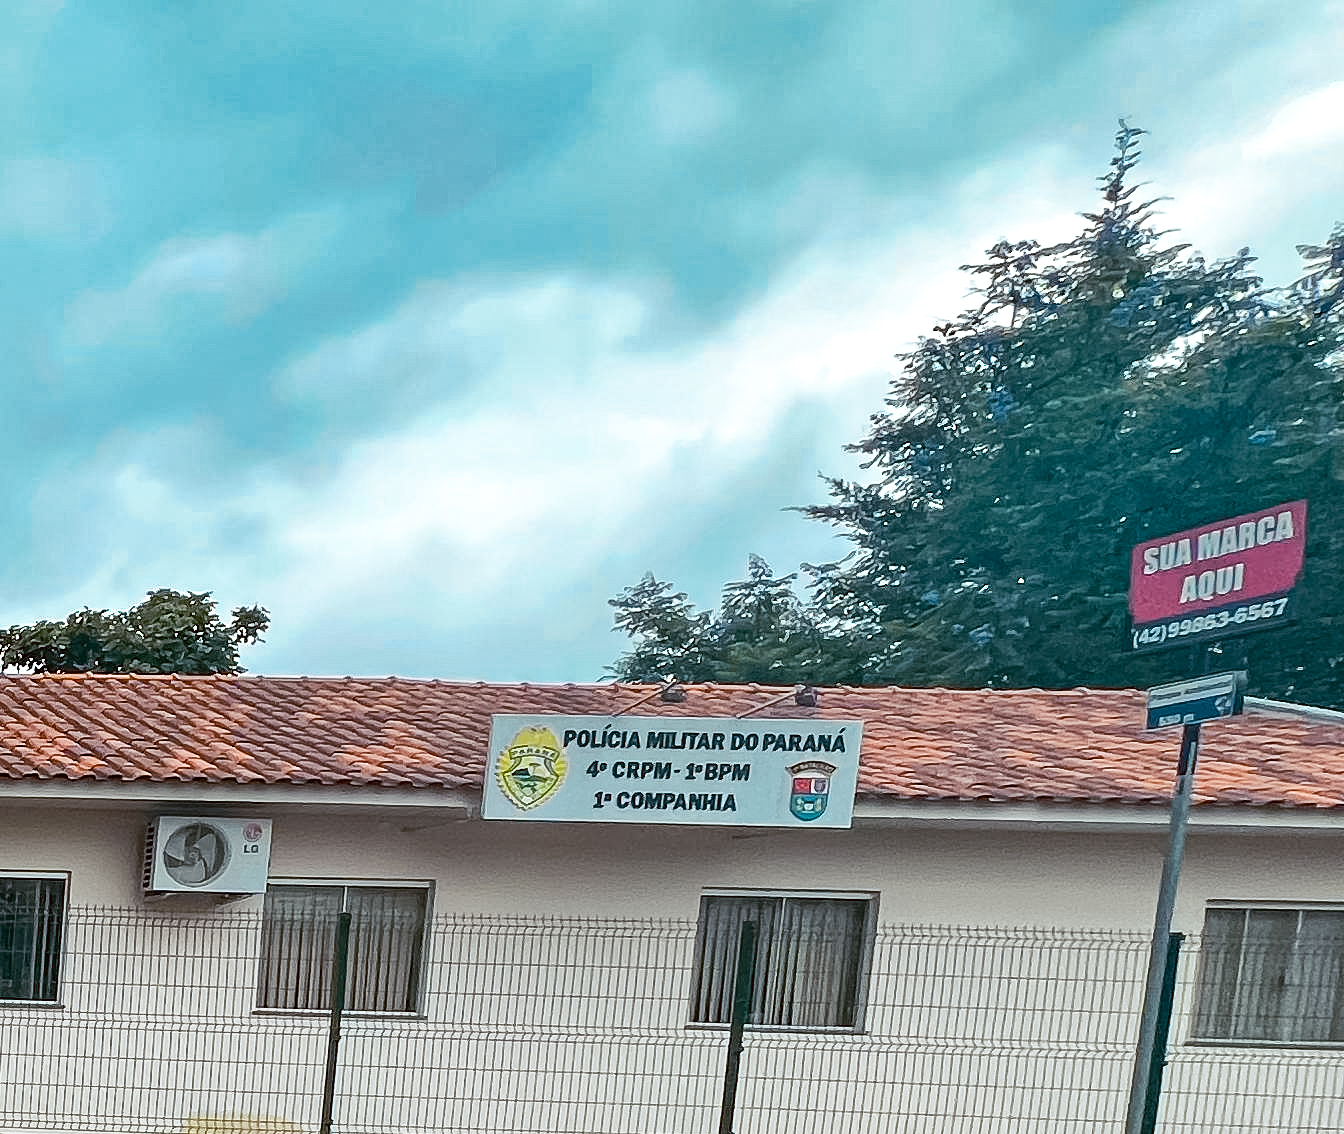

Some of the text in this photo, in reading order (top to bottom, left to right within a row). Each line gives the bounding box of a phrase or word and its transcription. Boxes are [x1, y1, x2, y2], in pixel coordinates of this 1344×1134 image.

[1143, 511, 1294, 575] SUA MARCA
[1179, 563, 1245, 604] AQUI
[563, 724, 848, 753] POLÍCIA MILITAR DO PARANÁ
[616, 792, 737, 812] COMPANHIA
